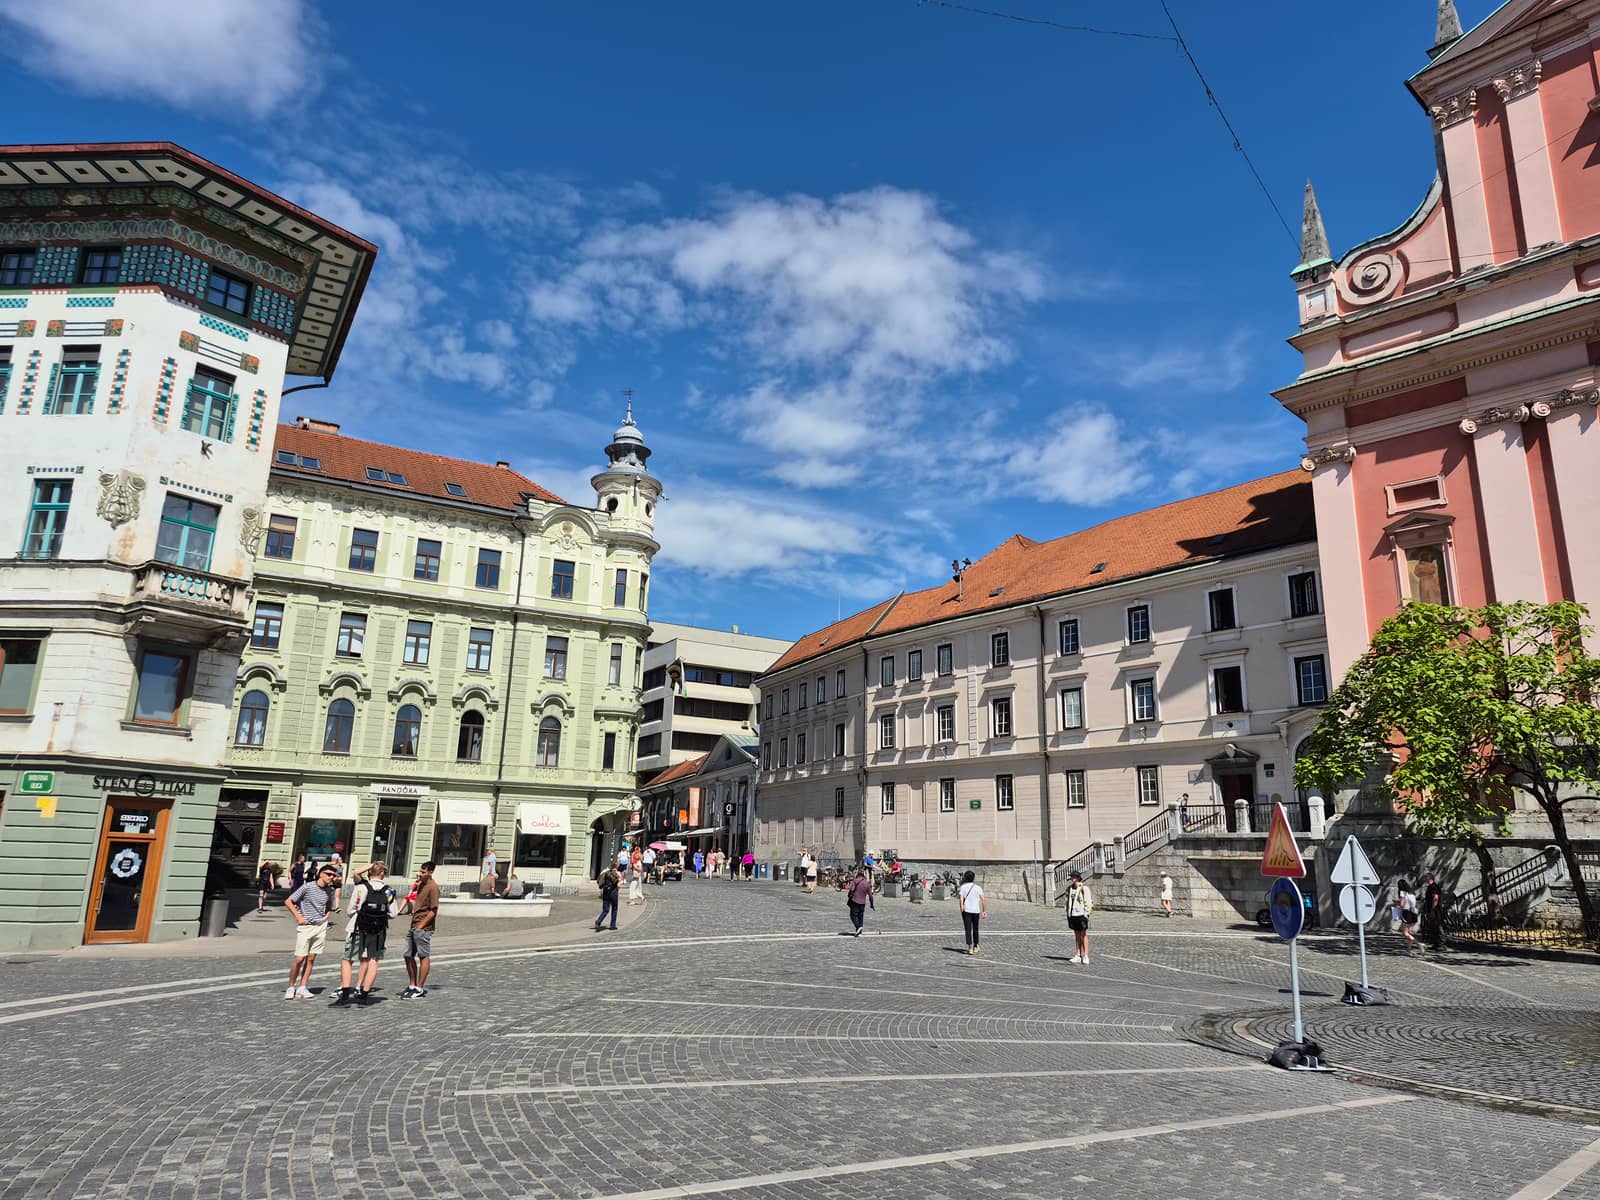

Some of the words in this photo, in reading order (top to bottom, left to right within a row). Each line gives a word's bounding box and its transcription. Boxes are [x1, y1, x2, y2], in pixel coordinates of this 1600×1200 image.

[93, 775, 132, 790] STEN
[160, 780, 196, 795] TIME
[382, 786, 418, 794] PANDORA
